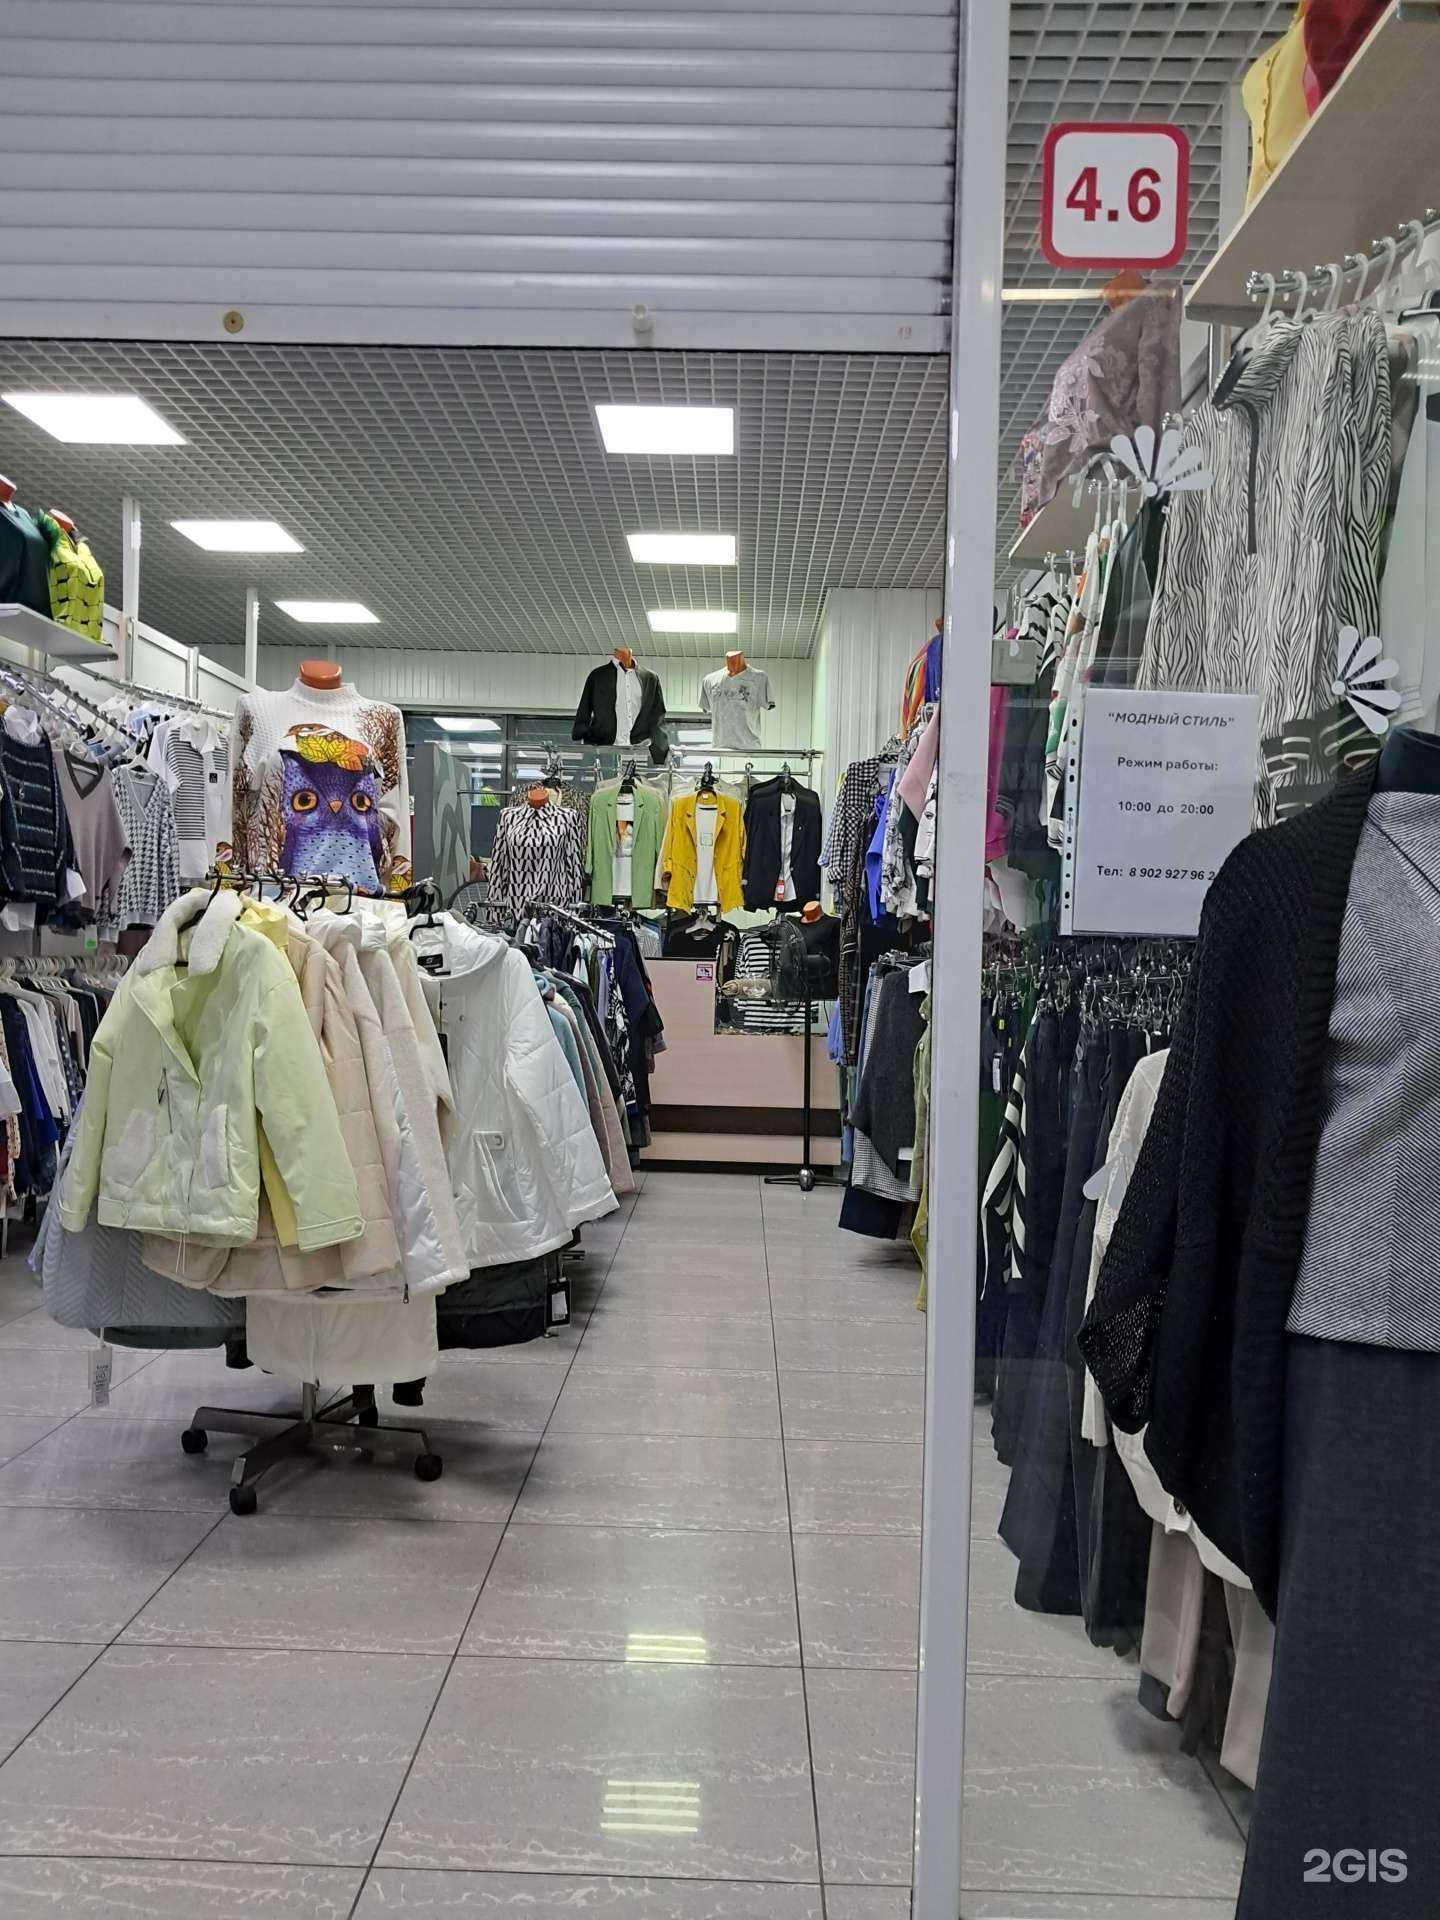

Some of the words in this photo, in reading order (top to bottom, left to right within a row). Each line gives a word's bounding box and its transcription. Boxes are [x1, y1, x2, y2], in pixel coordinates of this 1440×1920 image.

[1066, 166, 1162, 224] 4.6
[1117, 756, 1163, 769] Режим
[1166, 759, 1219, 772] работы:
[1118, 801, 1151, 812] 10:00
[1156, 805, 1174, 815] до
[1180, 804, 1214, 815] 20:00
[1097, 865, 1124, 877] Тел:
[1129, 867, 1137, 877] 8
[1140, 867, 1162, 879] 902
[1165, 869, 1188, 880] 927
[1190, 870, 1205, 881] 96
